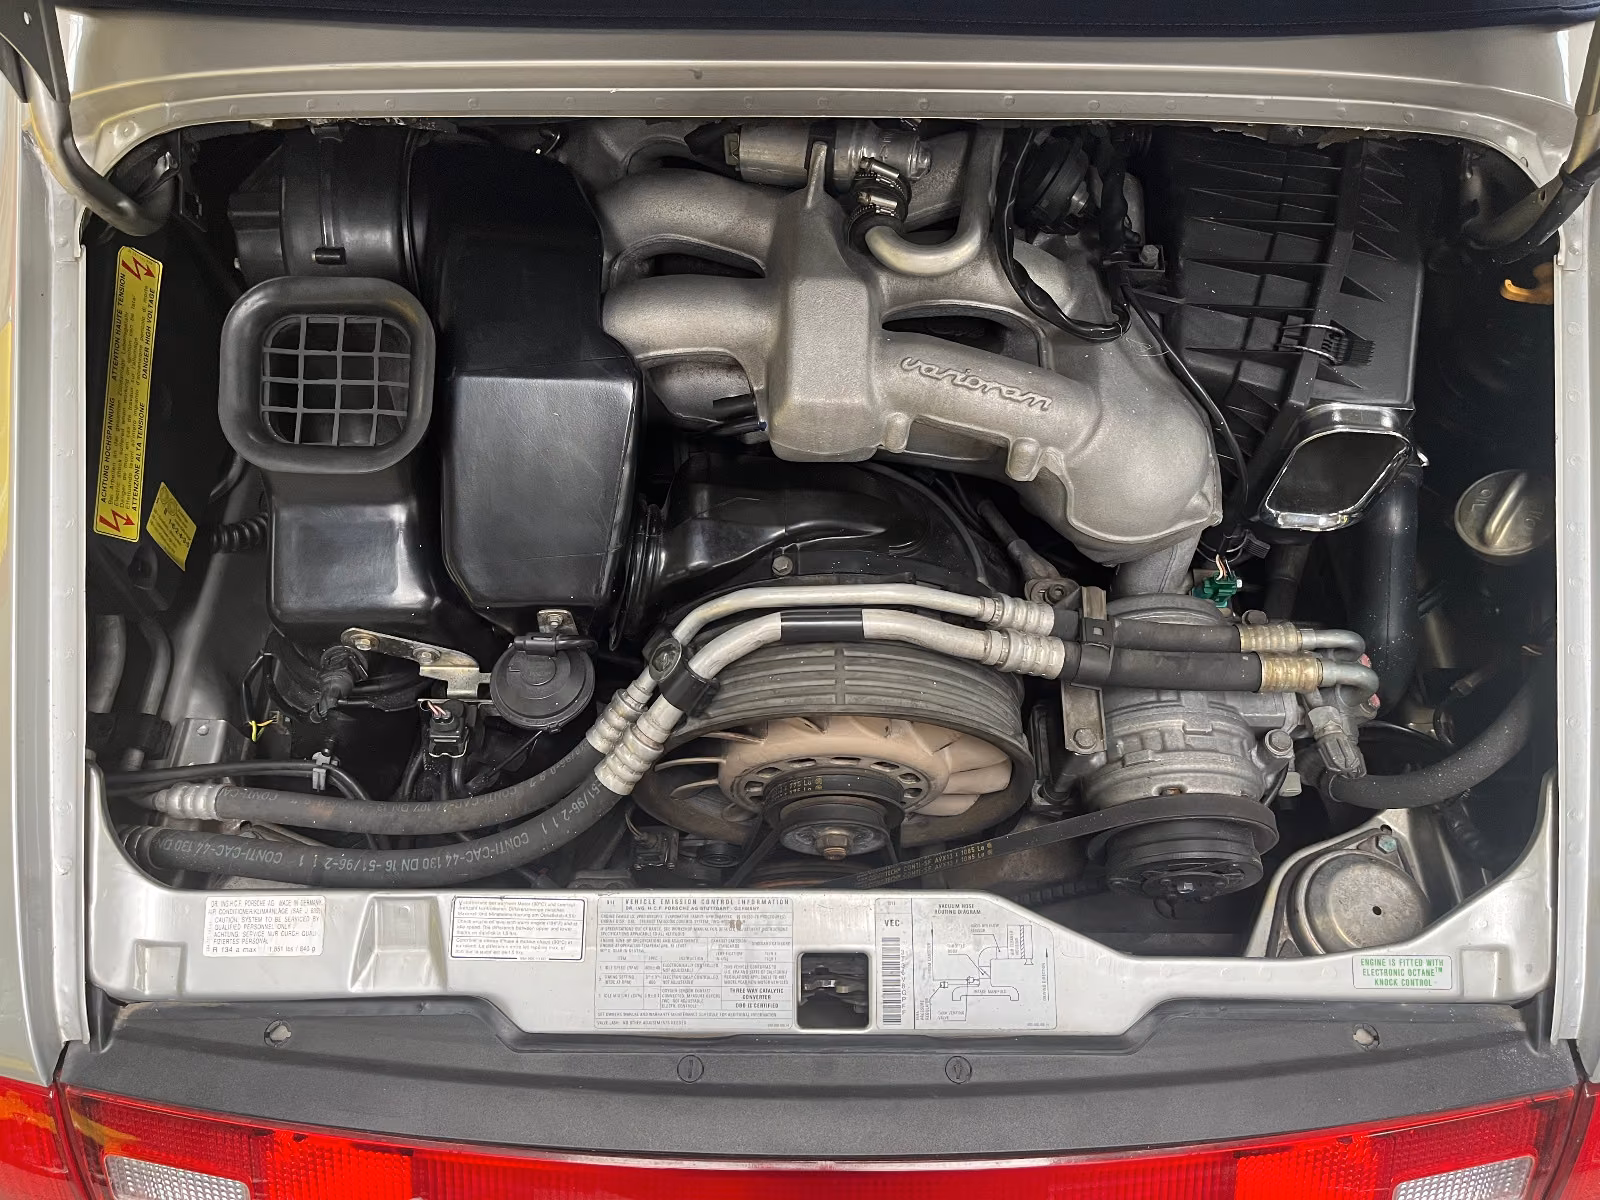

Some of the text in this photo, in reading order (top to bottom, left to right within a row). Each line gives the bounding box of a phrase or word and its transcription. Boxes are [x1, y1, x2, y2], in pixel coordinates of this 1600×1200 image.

[146, 287, 154, 323] VOLTAGE
[111, 336, 120, 380] ATTENTION
[901, 357, 1053, 411] varioram
[100, 396, 114, 503] ACHTUNG HOCHSPANNUNG
[130, 463, 140, 510] ATTENZIONE
[136, 402, 145, 439] TENSIONE
[196, 840, 283, 864] CONTI-CAC-44
[386, 859, 397, 872] 16
[401, 858, 419, 872] DN
[422, 856, 442, 870] 130
[445, 832, 530, 866] CONTI-CAC-44
